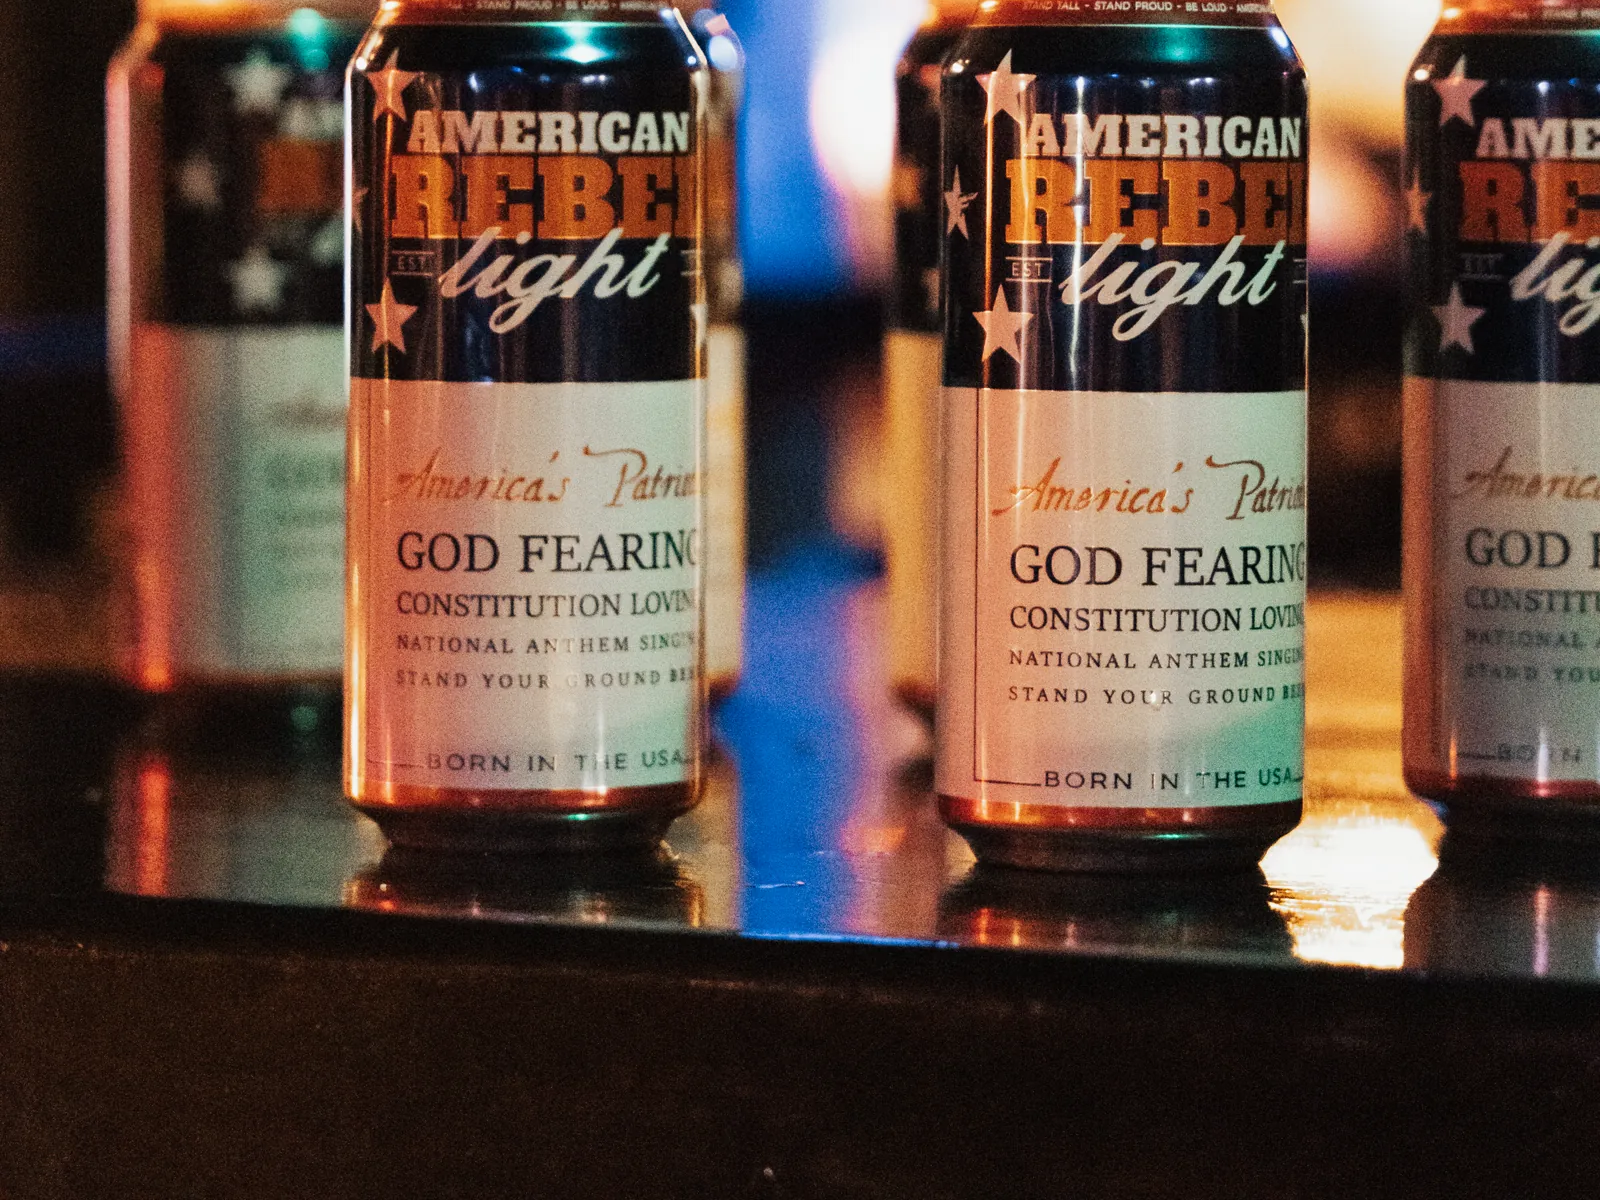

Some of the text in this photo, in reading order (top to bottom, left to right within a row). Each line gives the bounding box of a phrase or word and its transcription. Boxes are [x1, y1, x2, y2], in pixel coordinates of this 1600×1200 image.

[1094, 1, 1131, 11] STAND
[1135, 1, 1172, 11] PROUD
[1186, 2, 1198, 12] BE
[1202, 2, 1227, 13] LOUD
[407, 110, 690, 152] AMERICAN
[1024, 114, 1301, 157] AMERICAN
[438, 226, 671, 334] light
[1059, 233, 1287, 342] light
[391, 446, 571, 502] America's
[991, 456, 1195, 516] America's
[397, 531, 500, 573] GOD
[1010, 544, 1122, 585] GOD
[1465, 528, 1570, 569] GOD
[397, 590, 622, 618] CONSTITUTION
[1010, 605, 1241, 632] CONSTITUTION
[397, 634, 514, 654] NATIONAL
[526, 636, 630, 654] ANTHEM
[1009, 649, 1136, 669] NATIONAL
[1149, 652, 1249, 669] ANTHEM
[397, 670, 468, 688] STAND
[482, 672, 550, 689] YOUR
[565, 669, 661, 688] GROUND
[1008, 686, 1088, 702] STAND
[1103, 689, 1173, 704] YOUR
[1188, 687, 1275, 704] GROUND
[426, 753, 511, 772] BORN
[528, 755, 557, 772] IN
[574, 753, 628, 771] THE
[1045, 767, 1293, 791] BORN IN THE USA
